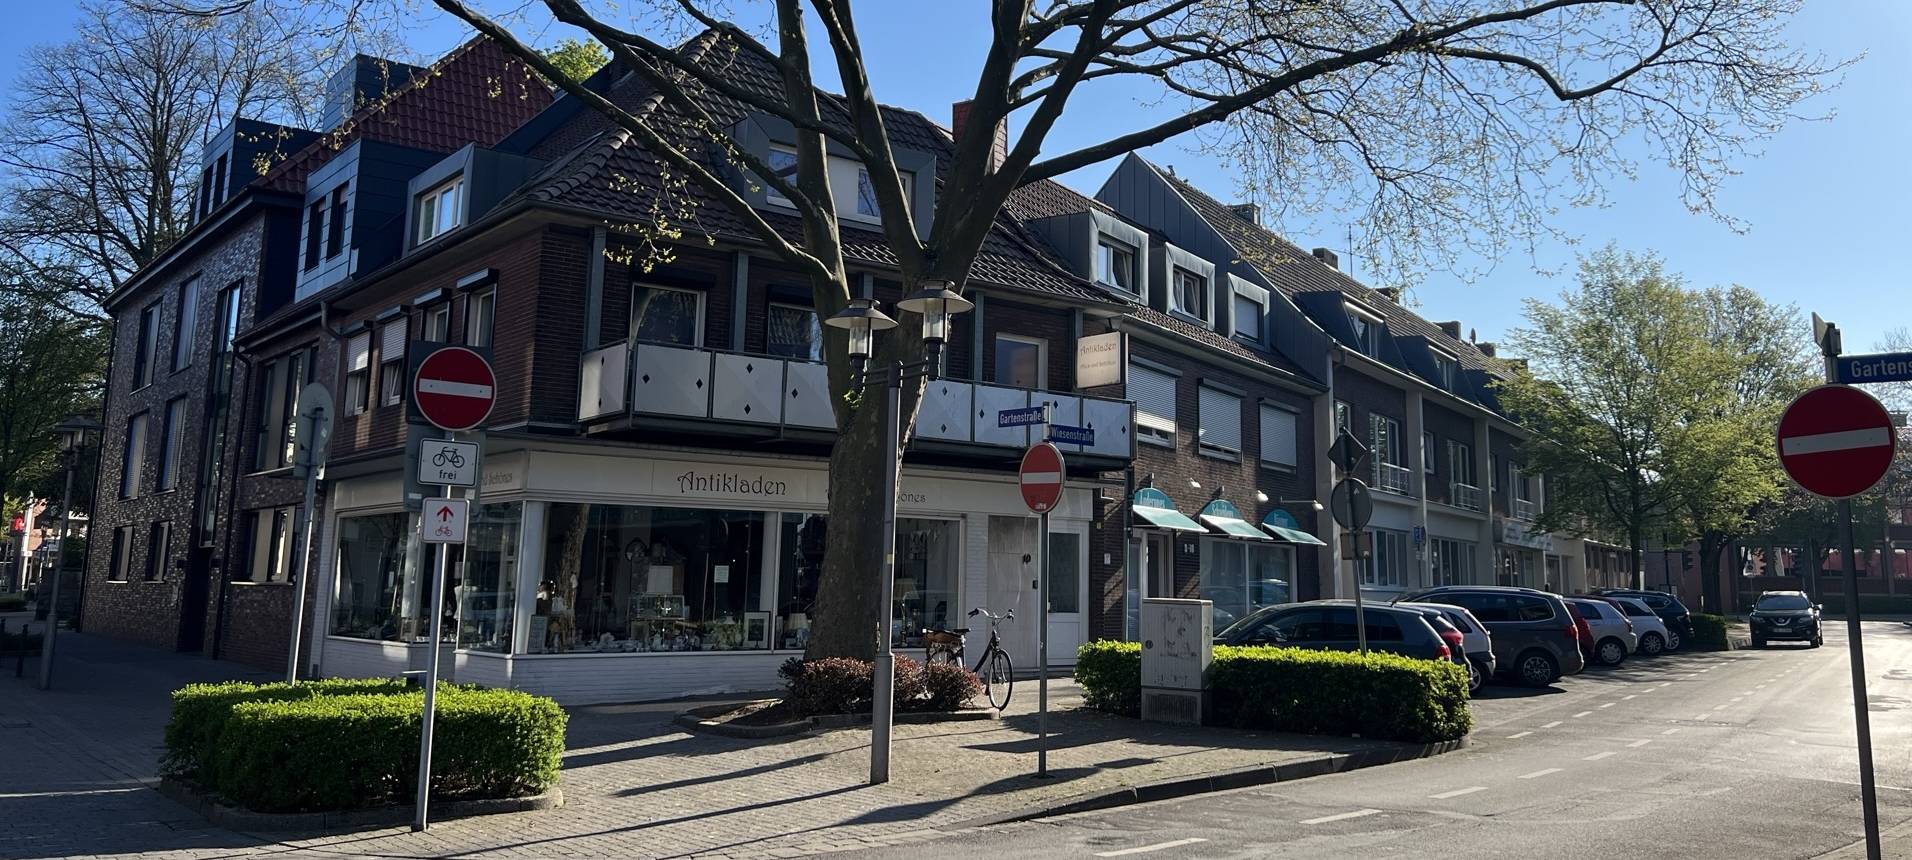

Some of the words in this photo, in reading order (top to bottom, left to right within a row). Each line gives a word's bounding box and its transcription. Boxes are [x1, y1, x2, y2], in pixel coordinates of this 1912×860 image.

[1080, 342, 1117, 357] Antikladen
[999, 410, 1042, 424] Gartenstraße
[1051, 427, 1094, 441] Wiesenstraße
[439, 469, 457, 480] frei
[677, 471, 786, 497] Antikladen
